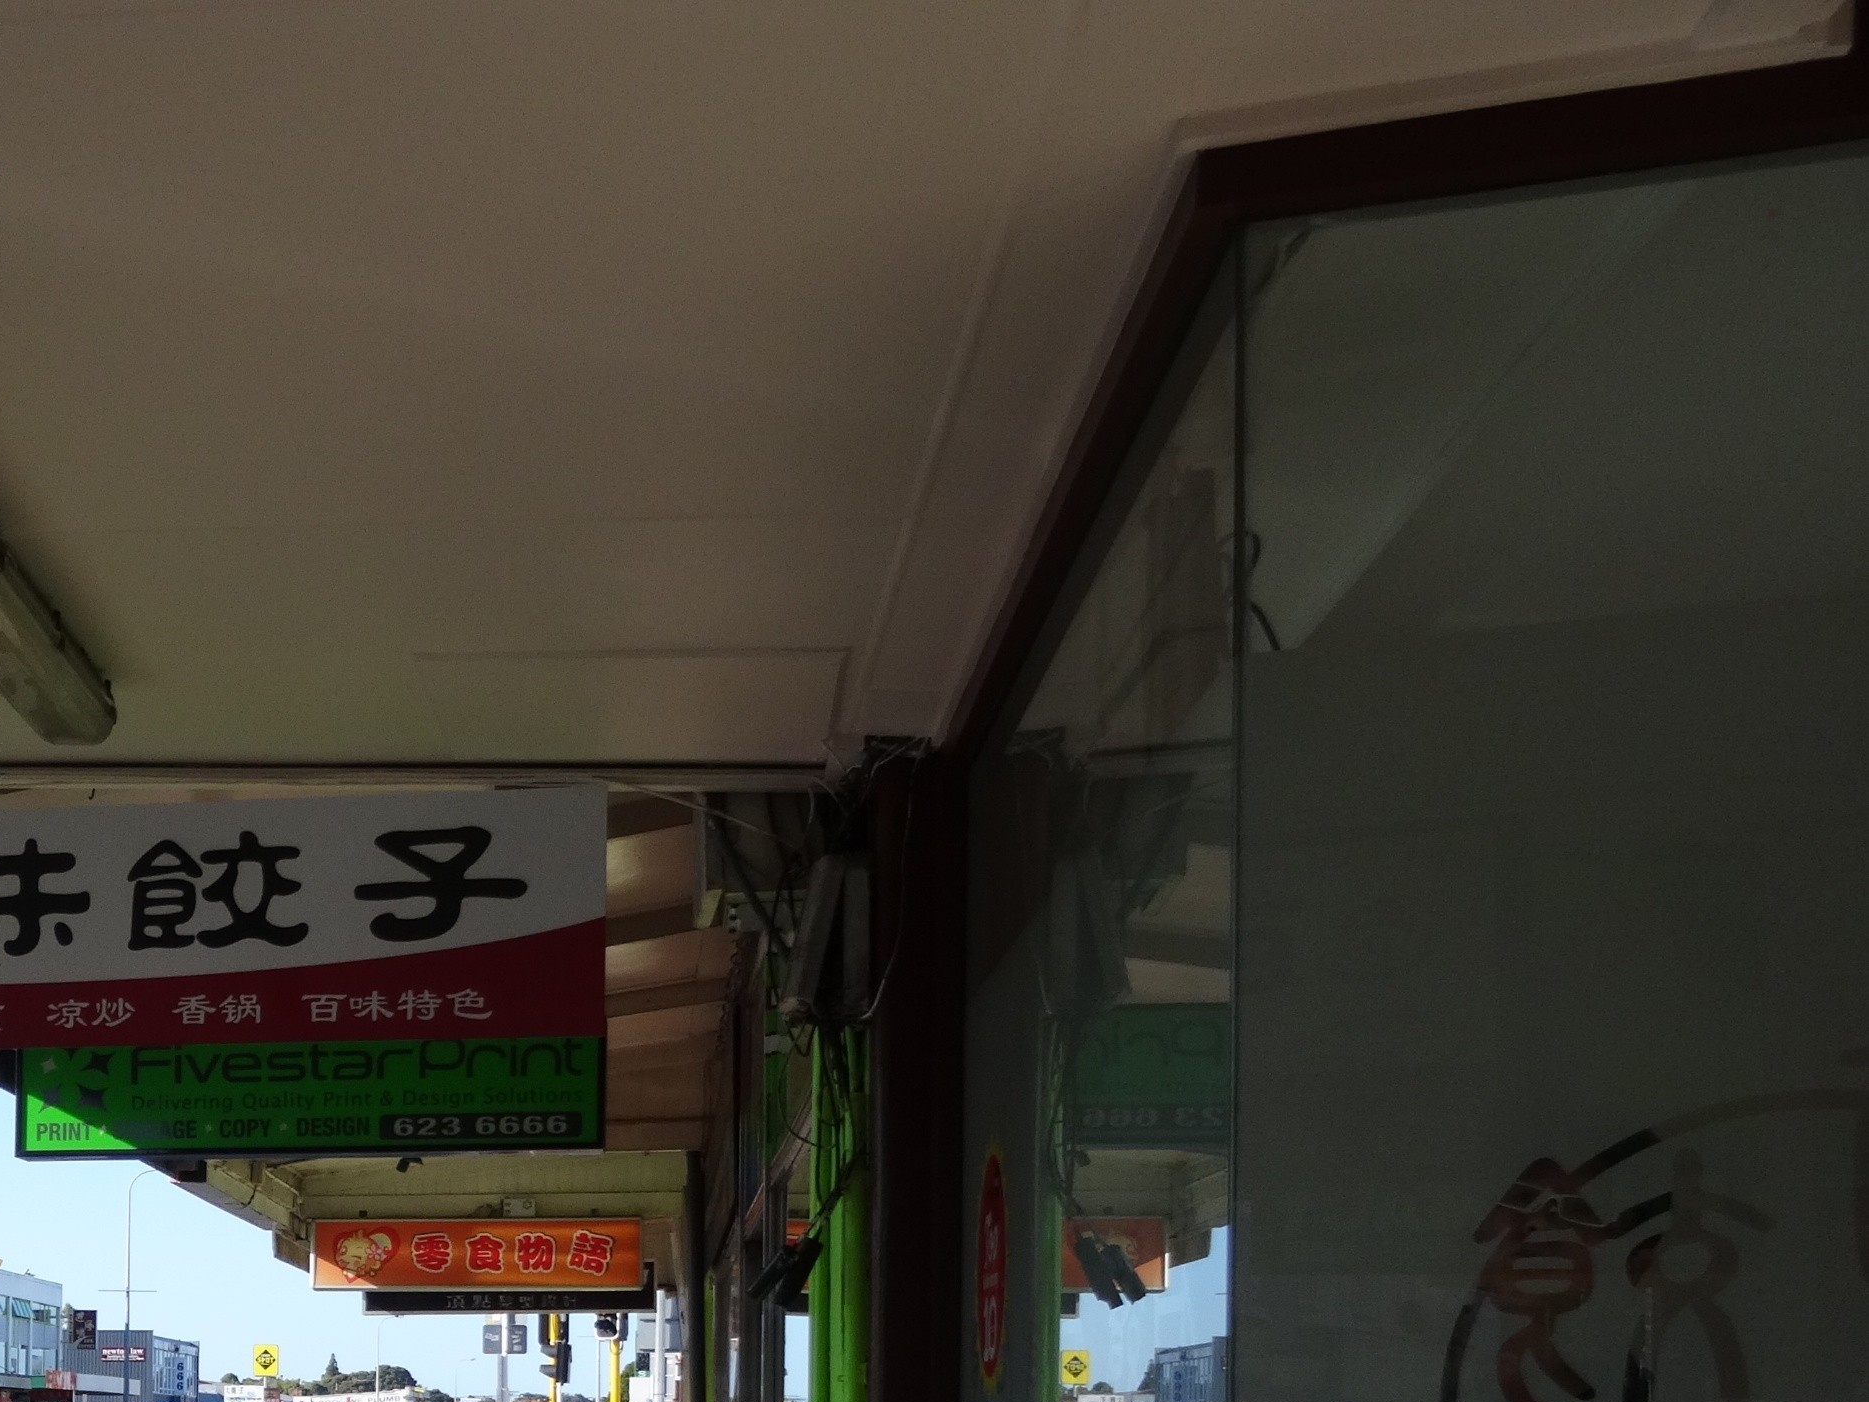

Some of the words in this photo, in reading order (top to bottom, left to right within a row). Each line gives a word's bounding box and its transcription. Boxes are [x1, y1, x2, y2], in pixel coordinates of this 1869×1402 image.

[46, 997, 137, 1029] 凉炒
[172, 994, 261, 1025] 香锅
[301, 988, 494, 1022] 百味特色
[131, 1094, 233, 1112] Delivering
[242, 1092, 312, 1111] Quality
[323, 1090, 371, 1107] Print
[379, 1090, 393, 1105] &
[403, 1089, 474, 1109] Design
[483, 1087, 583, 1105] Solutions
[37, 1123, 91, 1141] PRINT
[219, 1118, 272, 1138] COPY
[296, 1116, 371, 1137] DESIGN
[394, 1116, 461, 1136] 623
[475, 1115, 568, 1135] 6666
[412, 1229, 613, 1277] 零食物語
